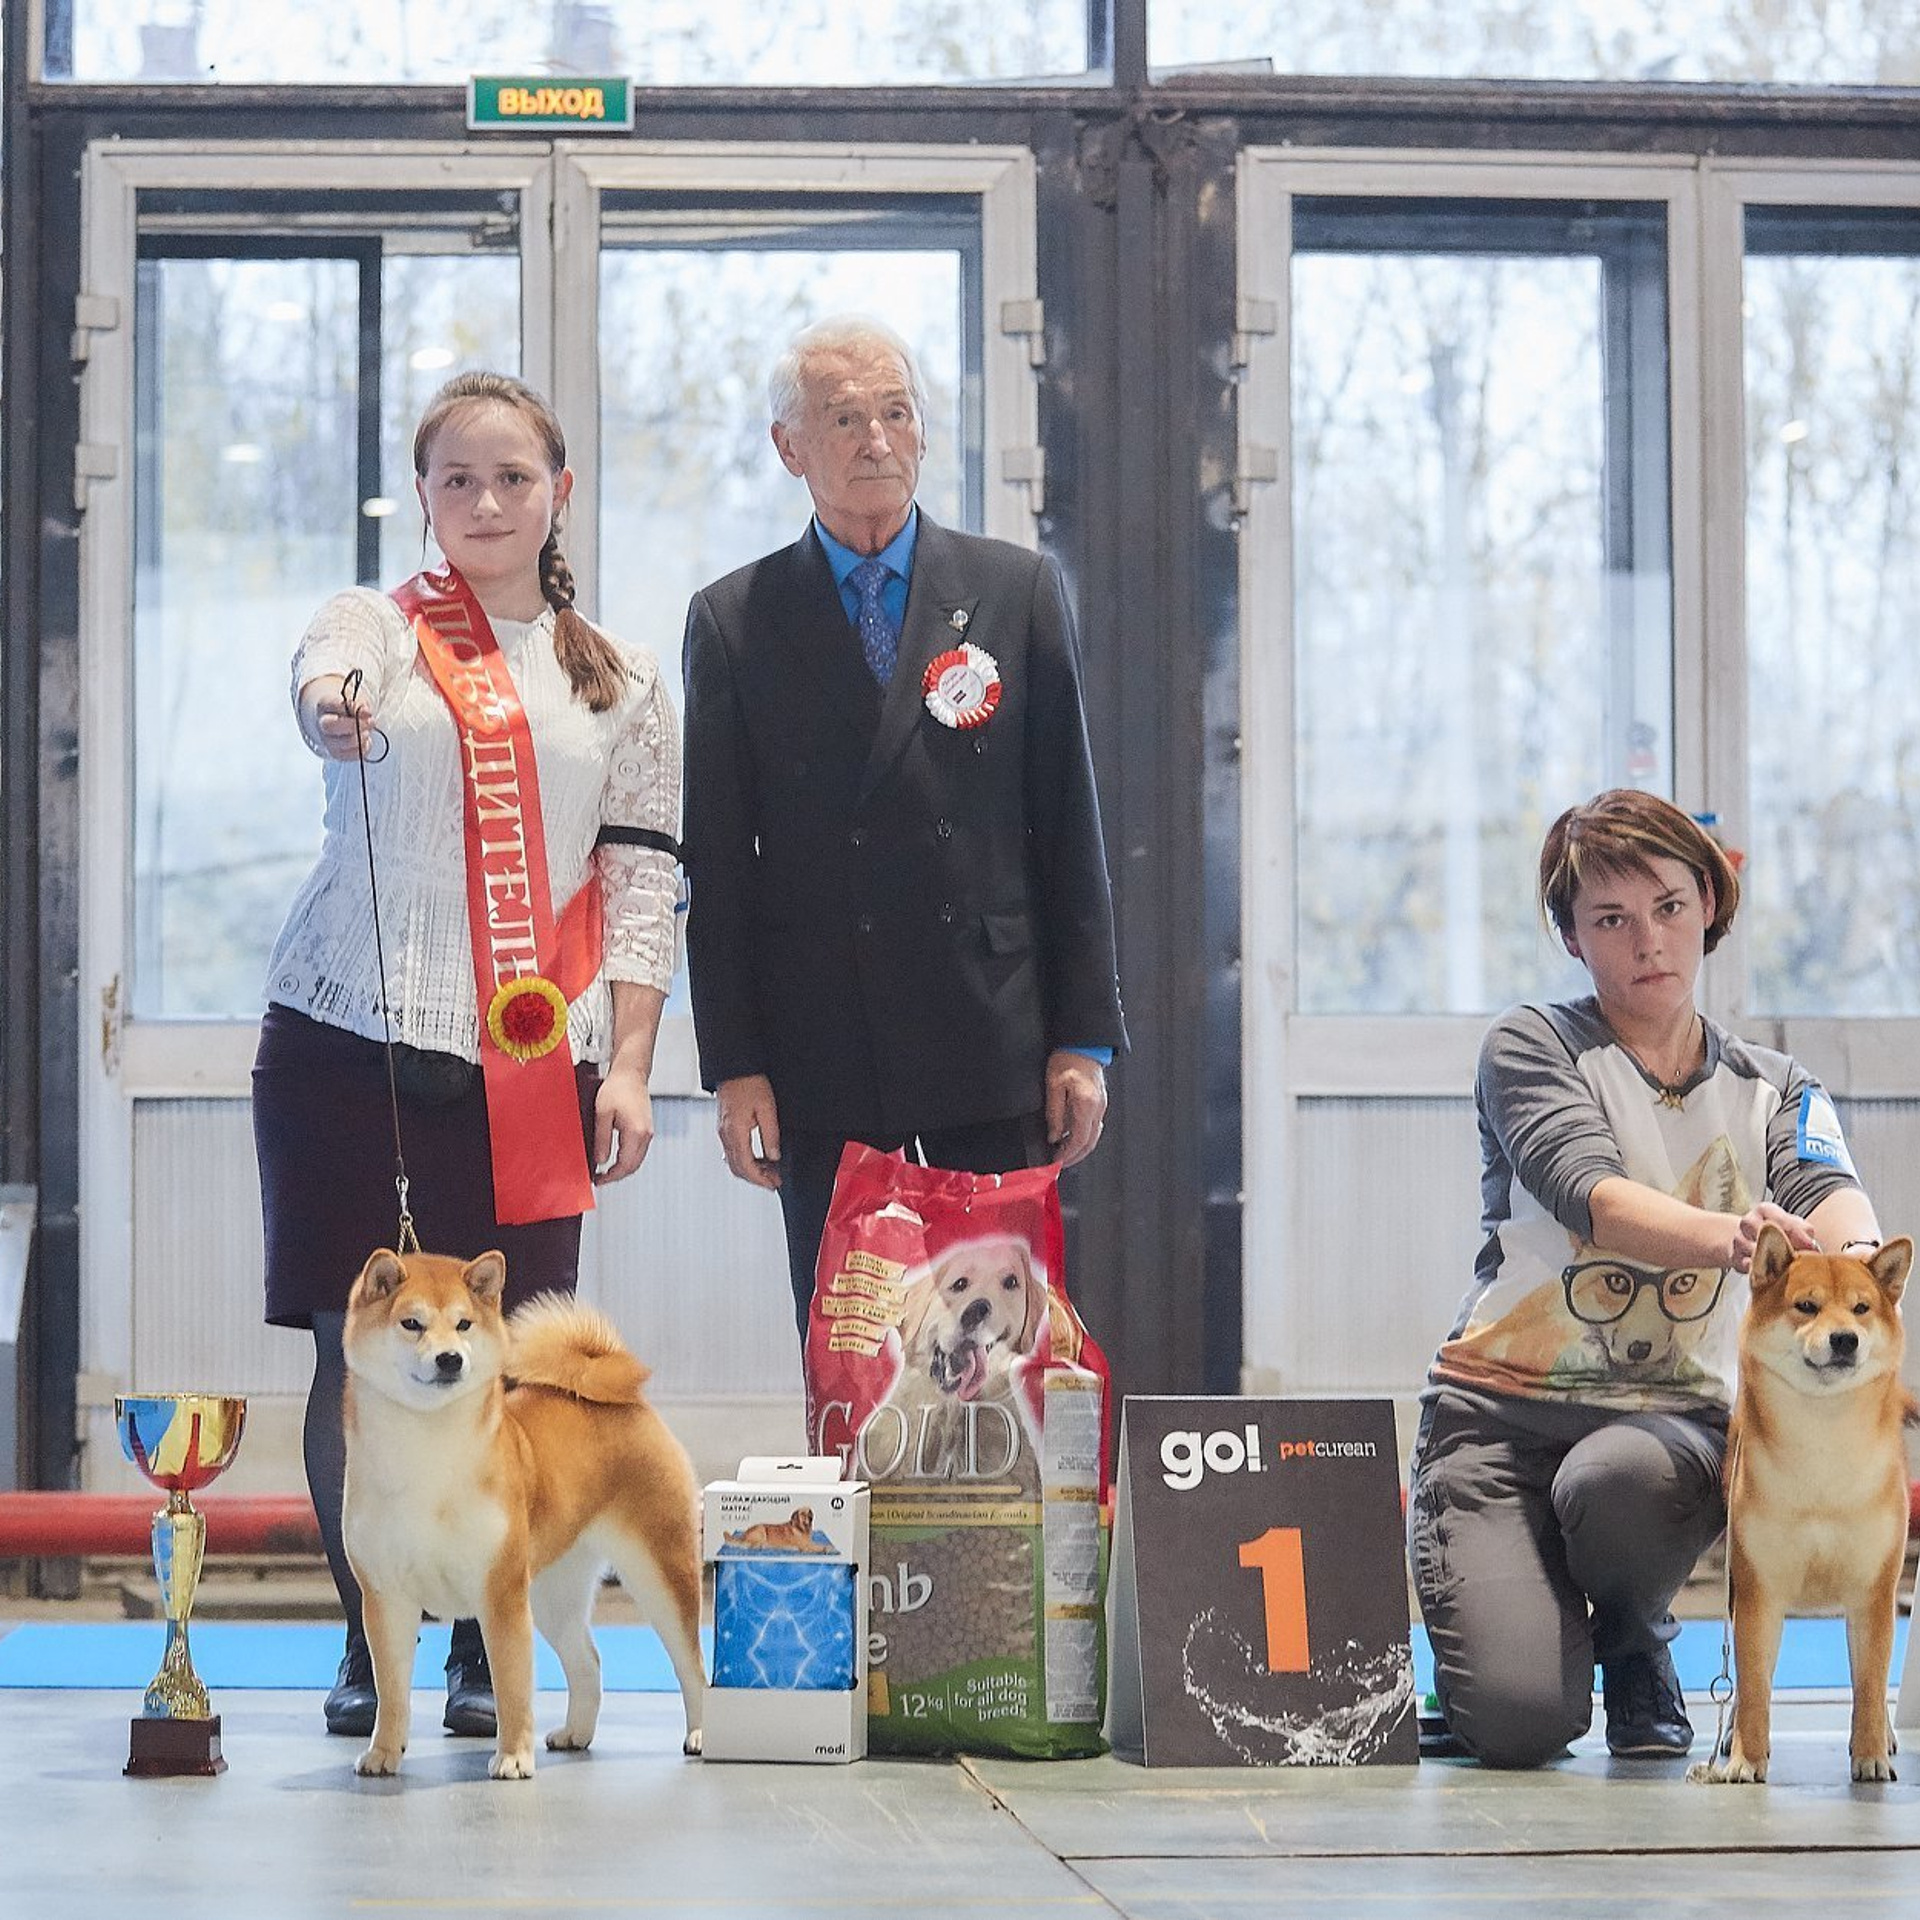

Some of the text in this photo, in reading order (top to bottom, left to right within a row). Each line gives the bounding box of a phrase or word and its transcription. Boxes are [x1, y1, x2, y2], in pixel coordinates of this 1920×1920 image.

[498, 88, 605, 119] ВЫХОД
[820, 1400, 1022, 1480] GOLD
[1160, 1424, 1377, 1491] go! petcurean
[1238, 1527, 1311, 1672] 1
[967, 1672, 1027, 1695] Suitable
[955, 1687, 1027, 1708] for all dog
[978, 1703, 1027, 1722] breeds
[814, 1742, 846, 1755] modi
